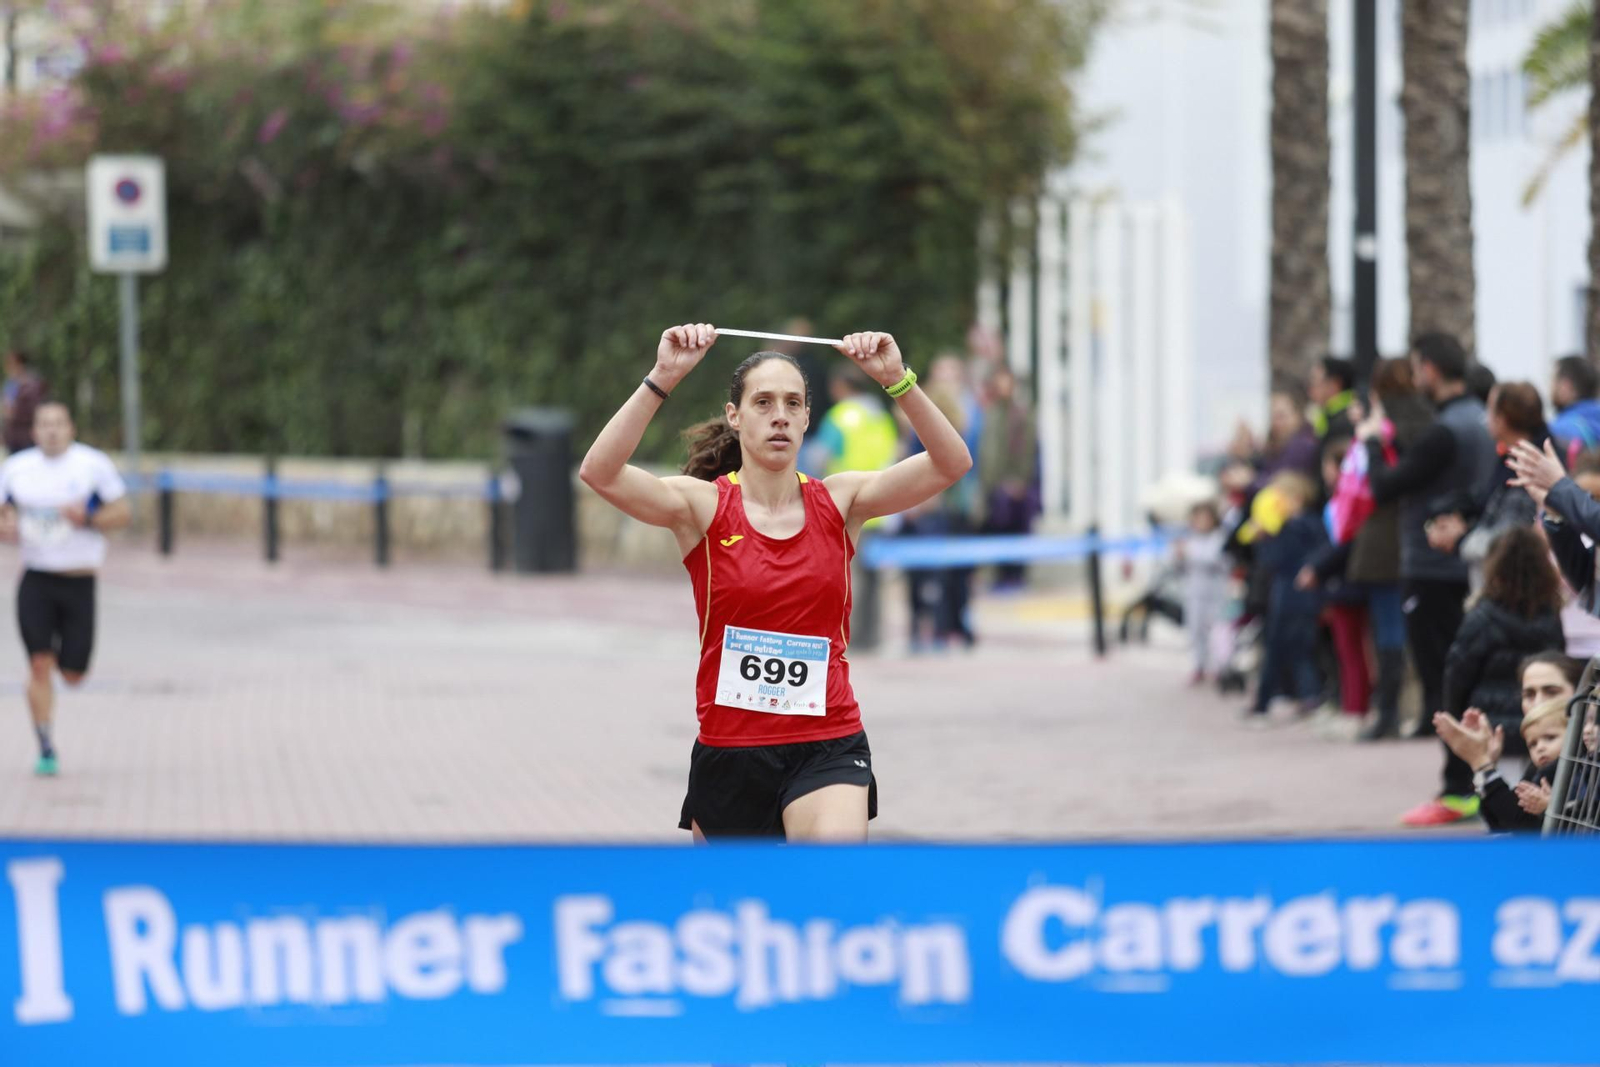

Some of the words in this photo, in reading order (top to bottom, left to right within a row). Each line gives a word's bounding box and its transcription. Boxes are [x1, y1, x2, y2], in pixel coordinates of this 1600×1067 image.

[730, 642, 742, 650] por
[743, 643, 752, 652] el
[736, 632, 758, 641] Runner
[786, 639, 811, 648] Carrera
[739, 654, 808, 687] 699
[758, 684, 785, 697] ROGGER
[10, 860, 72, 1023] I
[105, 889, 520, 1014] Runner
[557, 898, 968, 1015] Fashion
[1003, 888, 1458, 985] Carrera
[1494, 900, 1600, 983] az
